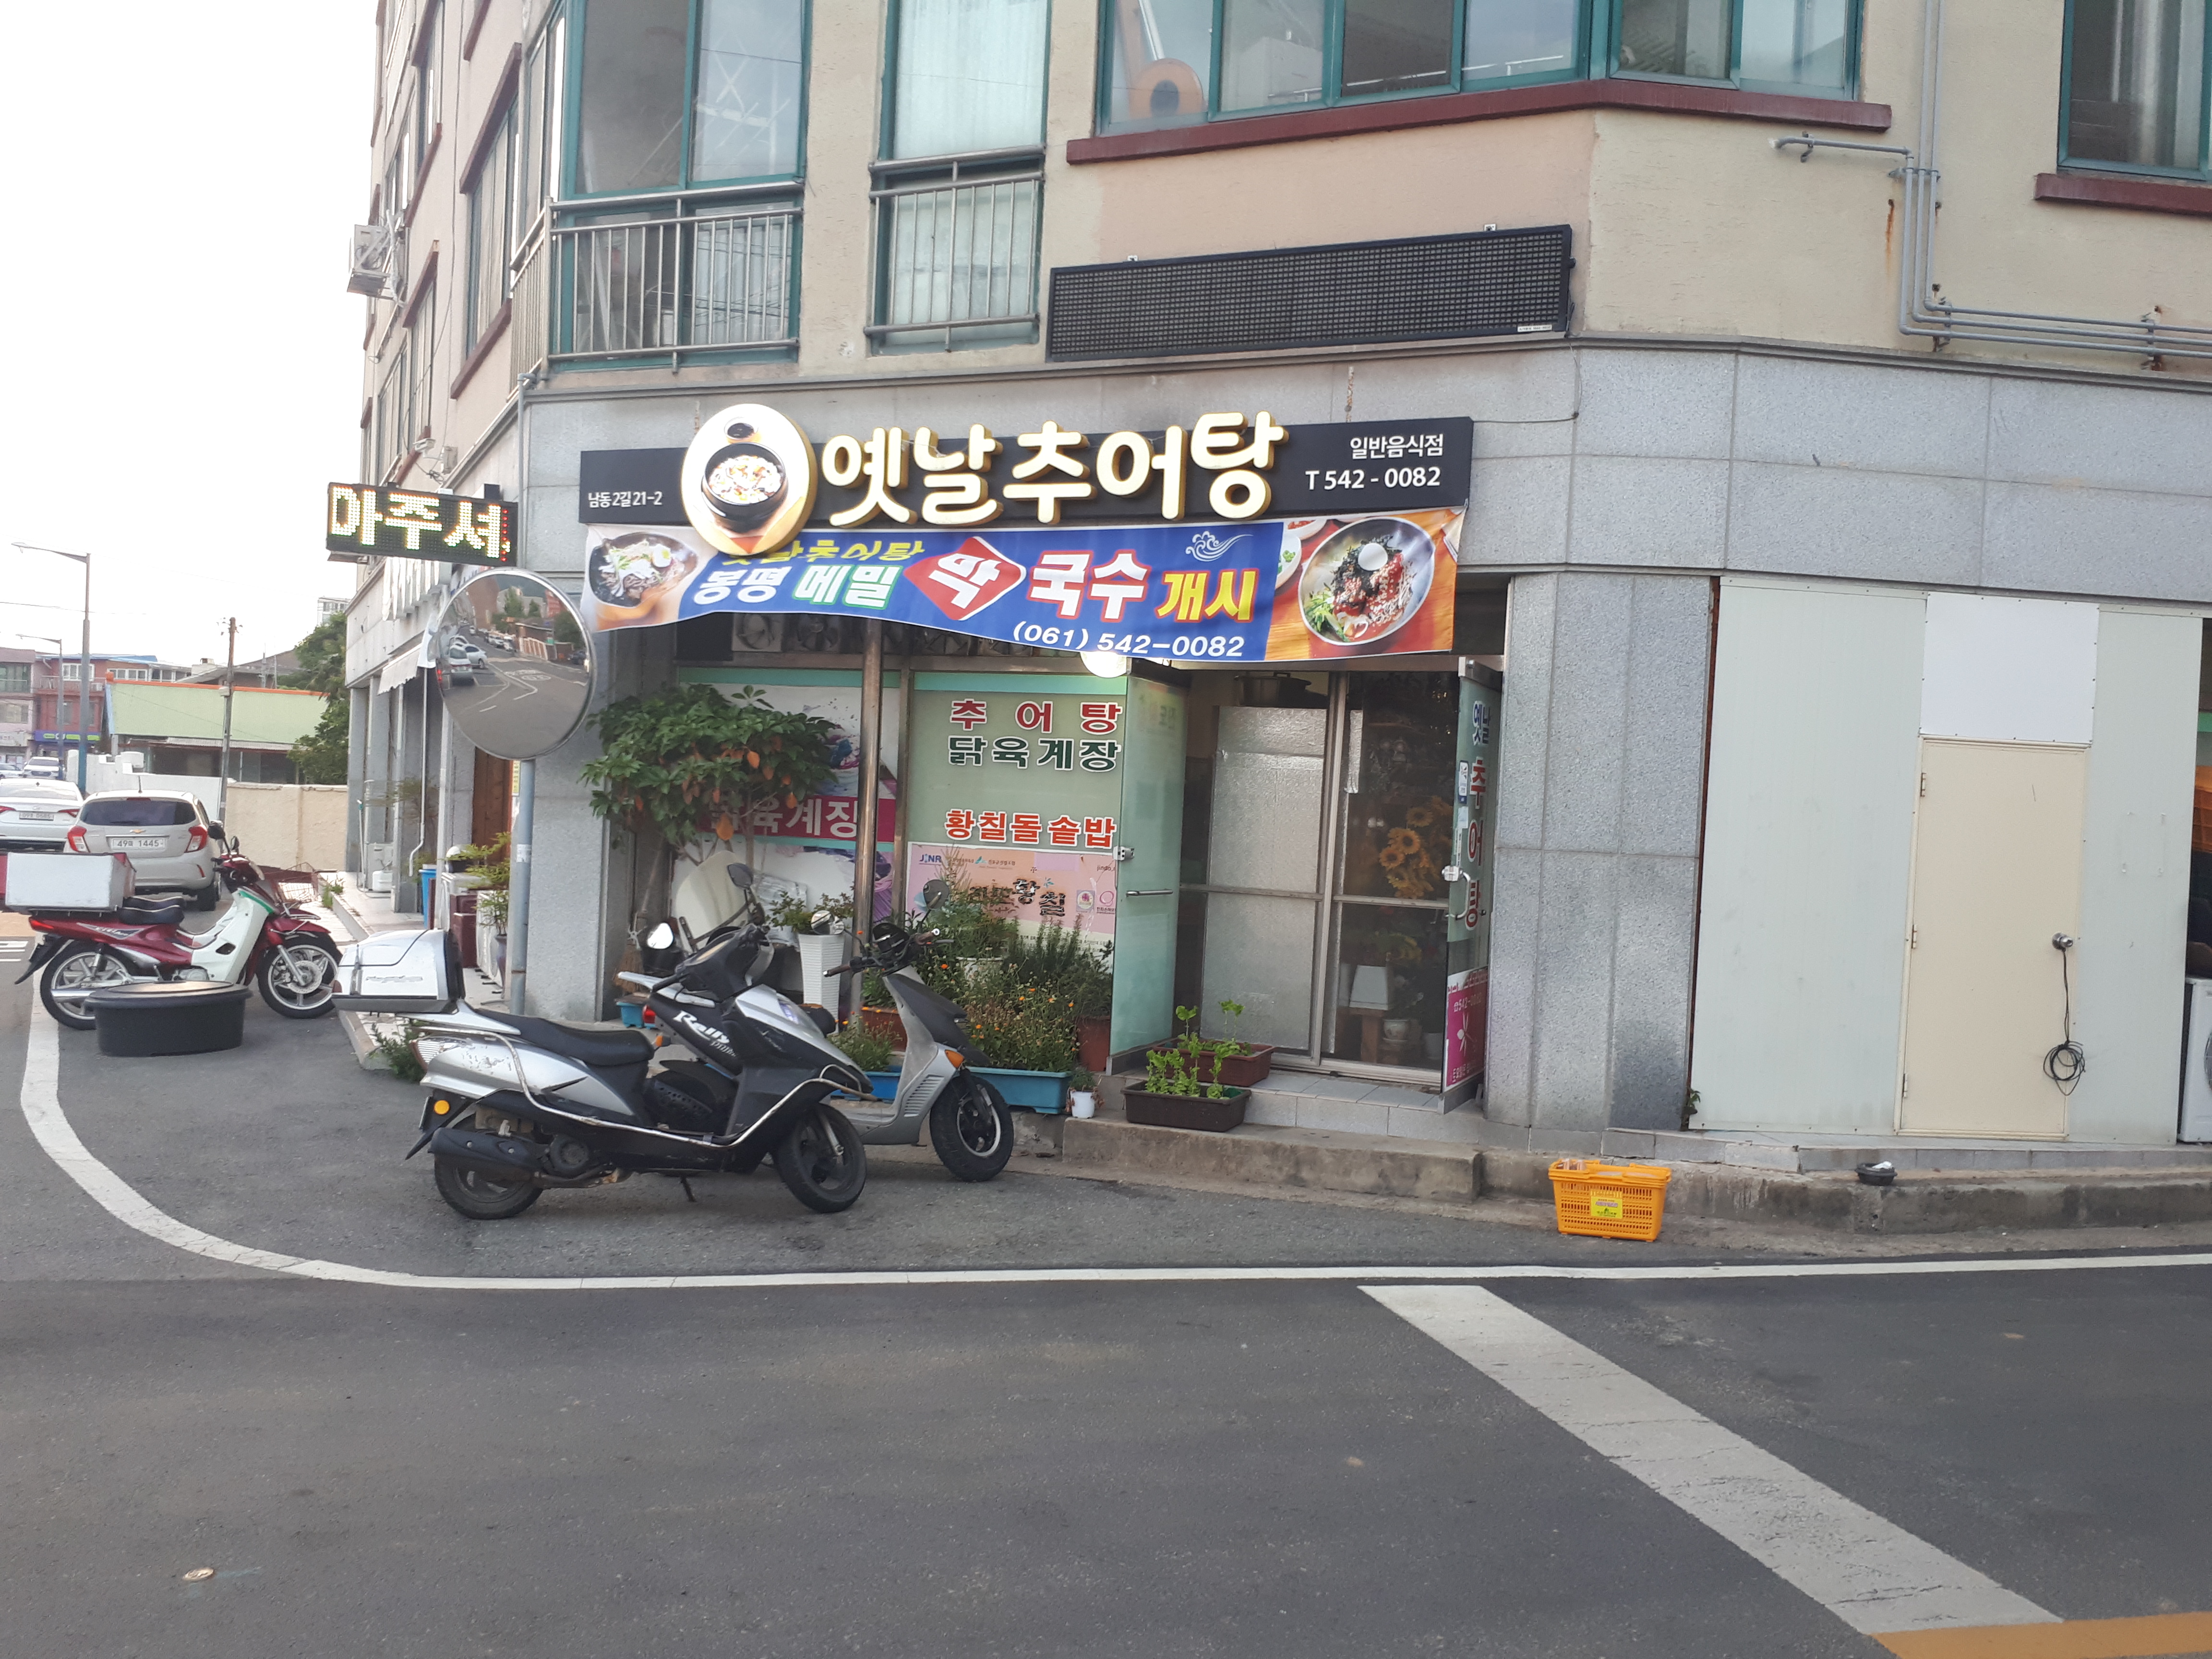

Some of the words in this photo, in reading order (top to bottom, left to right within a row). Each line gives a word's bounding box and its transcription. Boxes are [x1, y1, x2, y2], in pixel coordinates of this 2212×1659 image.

[1349, 433, 1443, 460] 일반음식점
[1157, 570, 1256, 622] 개시
[1013, 621, 1089, 648] (061)
[1097, 633, 1245, 657] 542-0082
